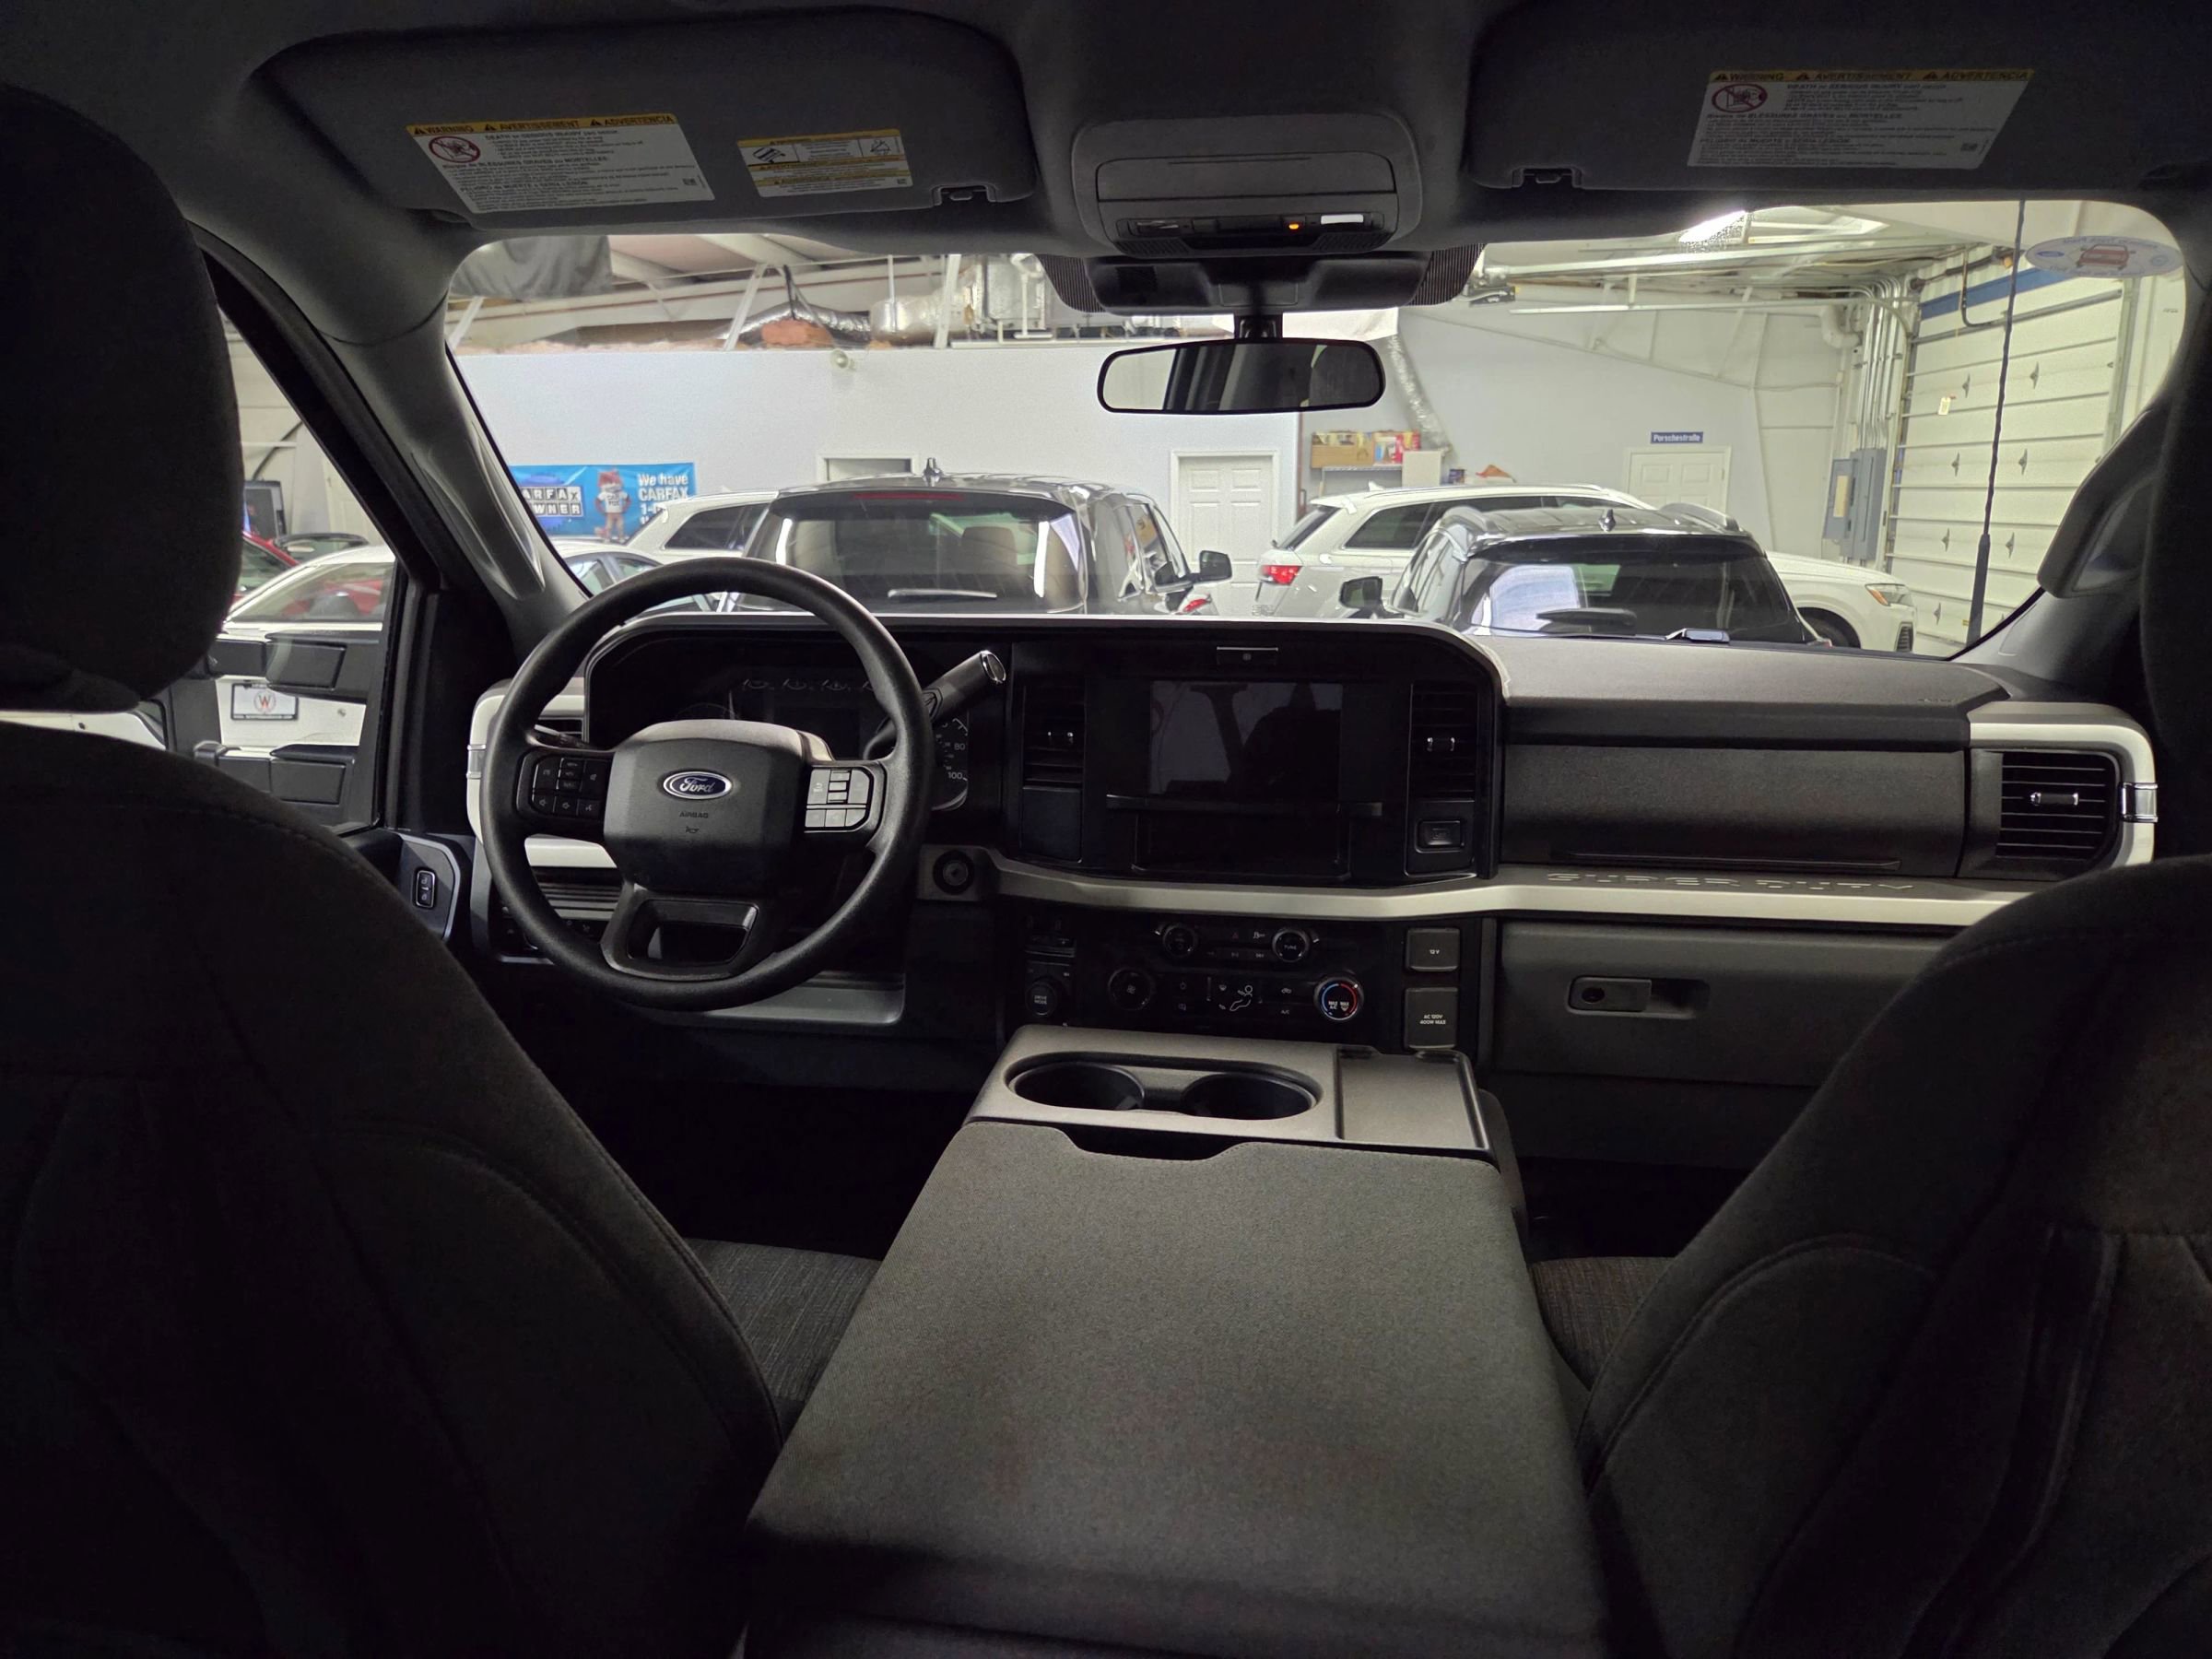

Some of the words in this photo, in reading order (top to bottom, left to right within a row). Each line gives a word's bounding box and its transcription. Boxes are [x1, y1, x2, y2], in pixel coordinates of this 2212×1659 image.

[426, 125, 474, 134] WARNING
[638, 474, 656, 486] We
[658, 472, 688, 486] have
[522, 488, 581, 501] ARFAX
[638, 487, 688, 501] CARFAX
[533, 503, 582, 515] WNER
[954, 743, 966, 751] 80
[947, 771, 963, 780] 100
[679, 776, 716, 793] Ford
